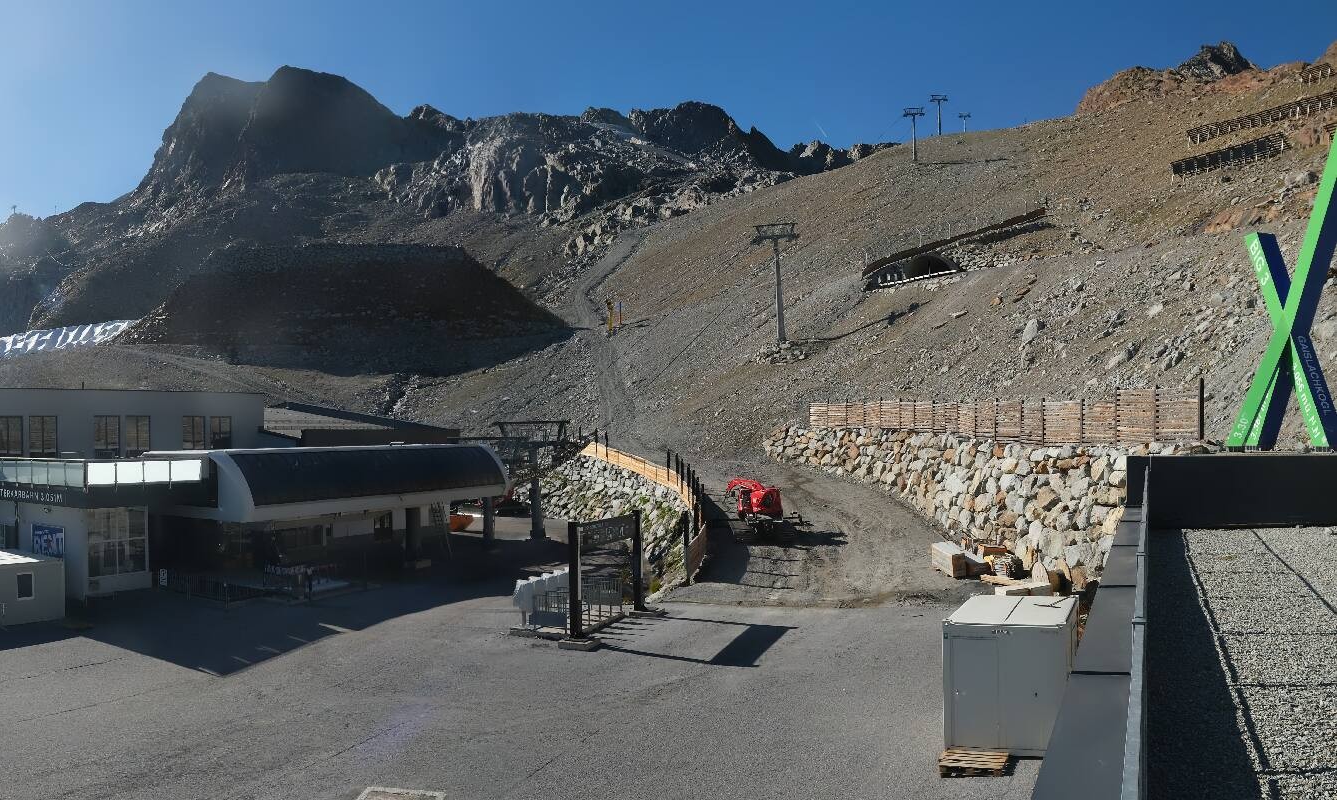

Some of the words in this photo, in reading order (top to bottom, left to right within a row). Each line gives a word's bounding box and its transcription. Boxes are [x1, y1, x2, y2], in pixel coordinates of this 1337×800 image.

[1250, 239, 1265, 272] BIG
[1260, 272, 1270, 286] 3
[1296, 335, 1332, 416] GAISLACHKOGL
